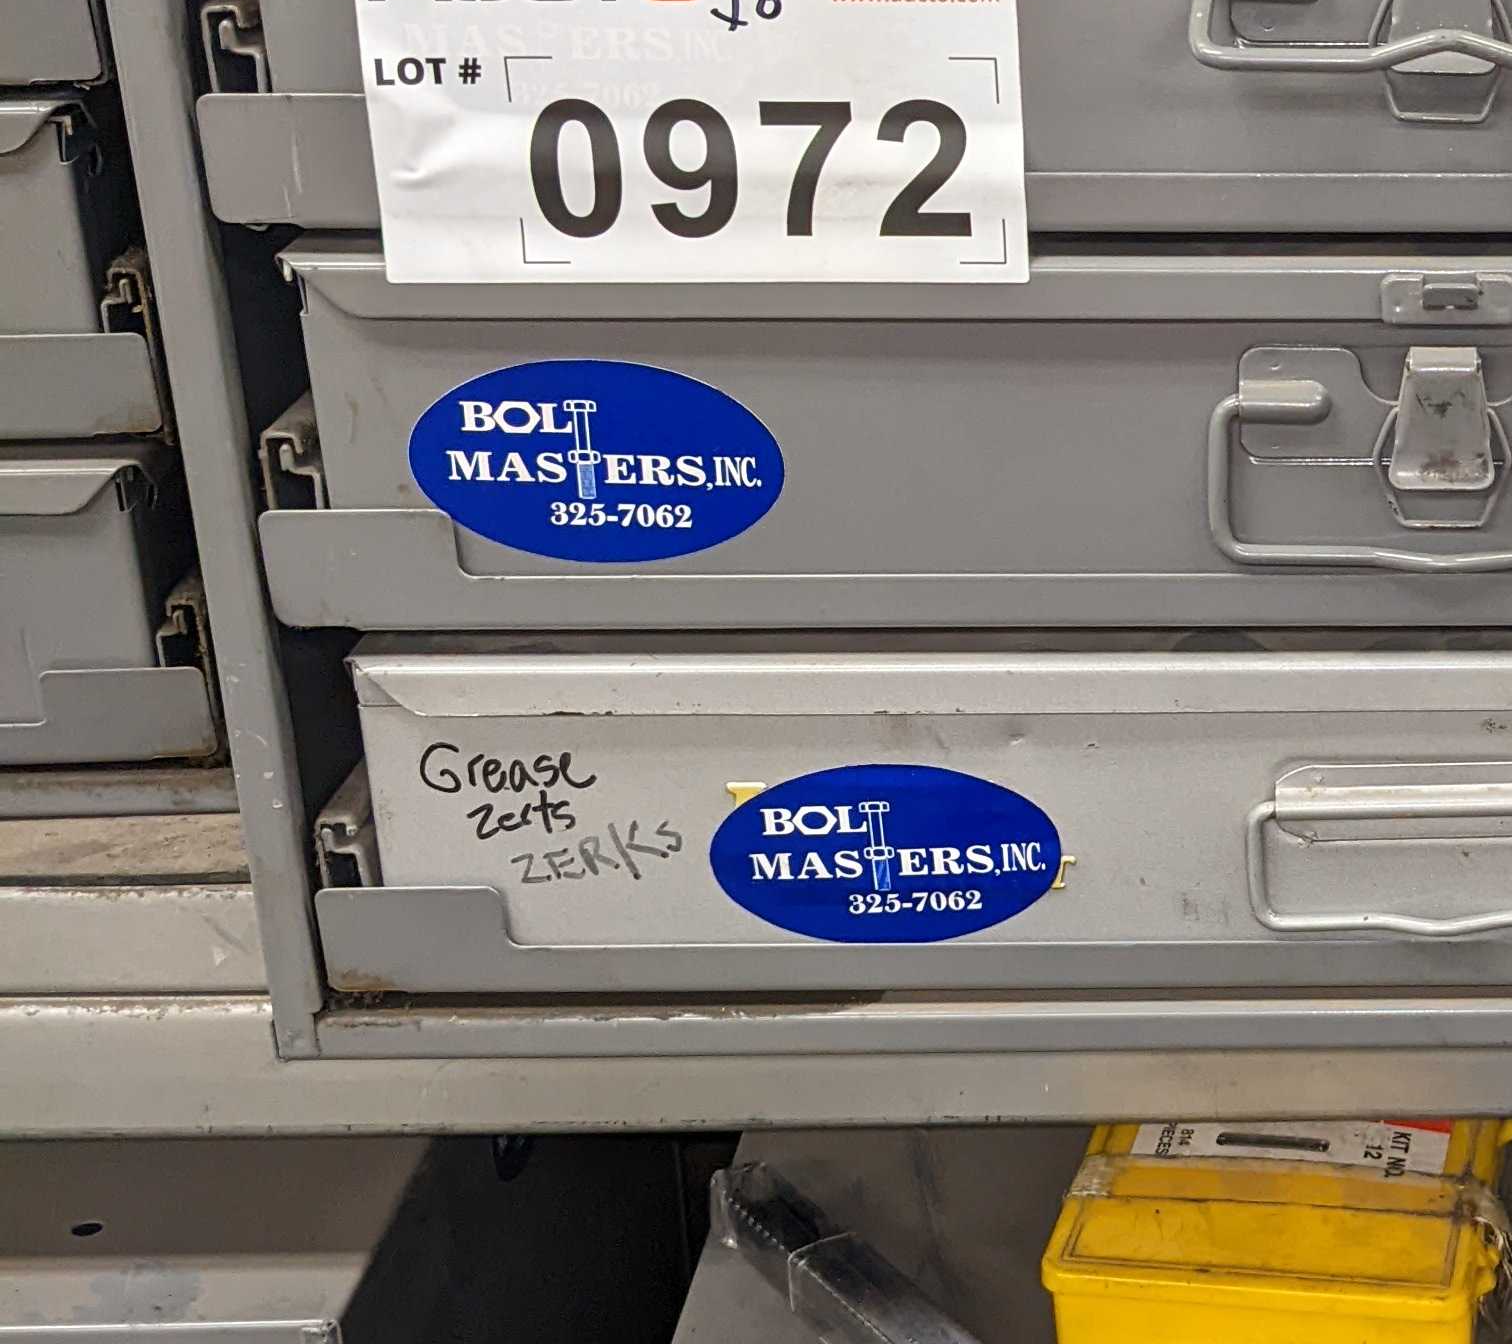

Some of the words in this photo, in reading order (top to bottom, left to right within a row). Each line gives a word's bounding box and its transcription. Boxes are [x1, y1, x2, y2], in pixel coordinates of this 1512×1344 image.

[374, 58, 447, 86] LOT
[457, 57, 482, 85] #
[529, 98, 973, 239] 0972
[549, 501, 693, 529] 325-7062
[419, 742, 598, 794] Grease
[848, 890, 984, 915] 325-7062
[1363, 1144, 1385, 1160] 12
[1390, 1131, 1412, 1153] KIT
